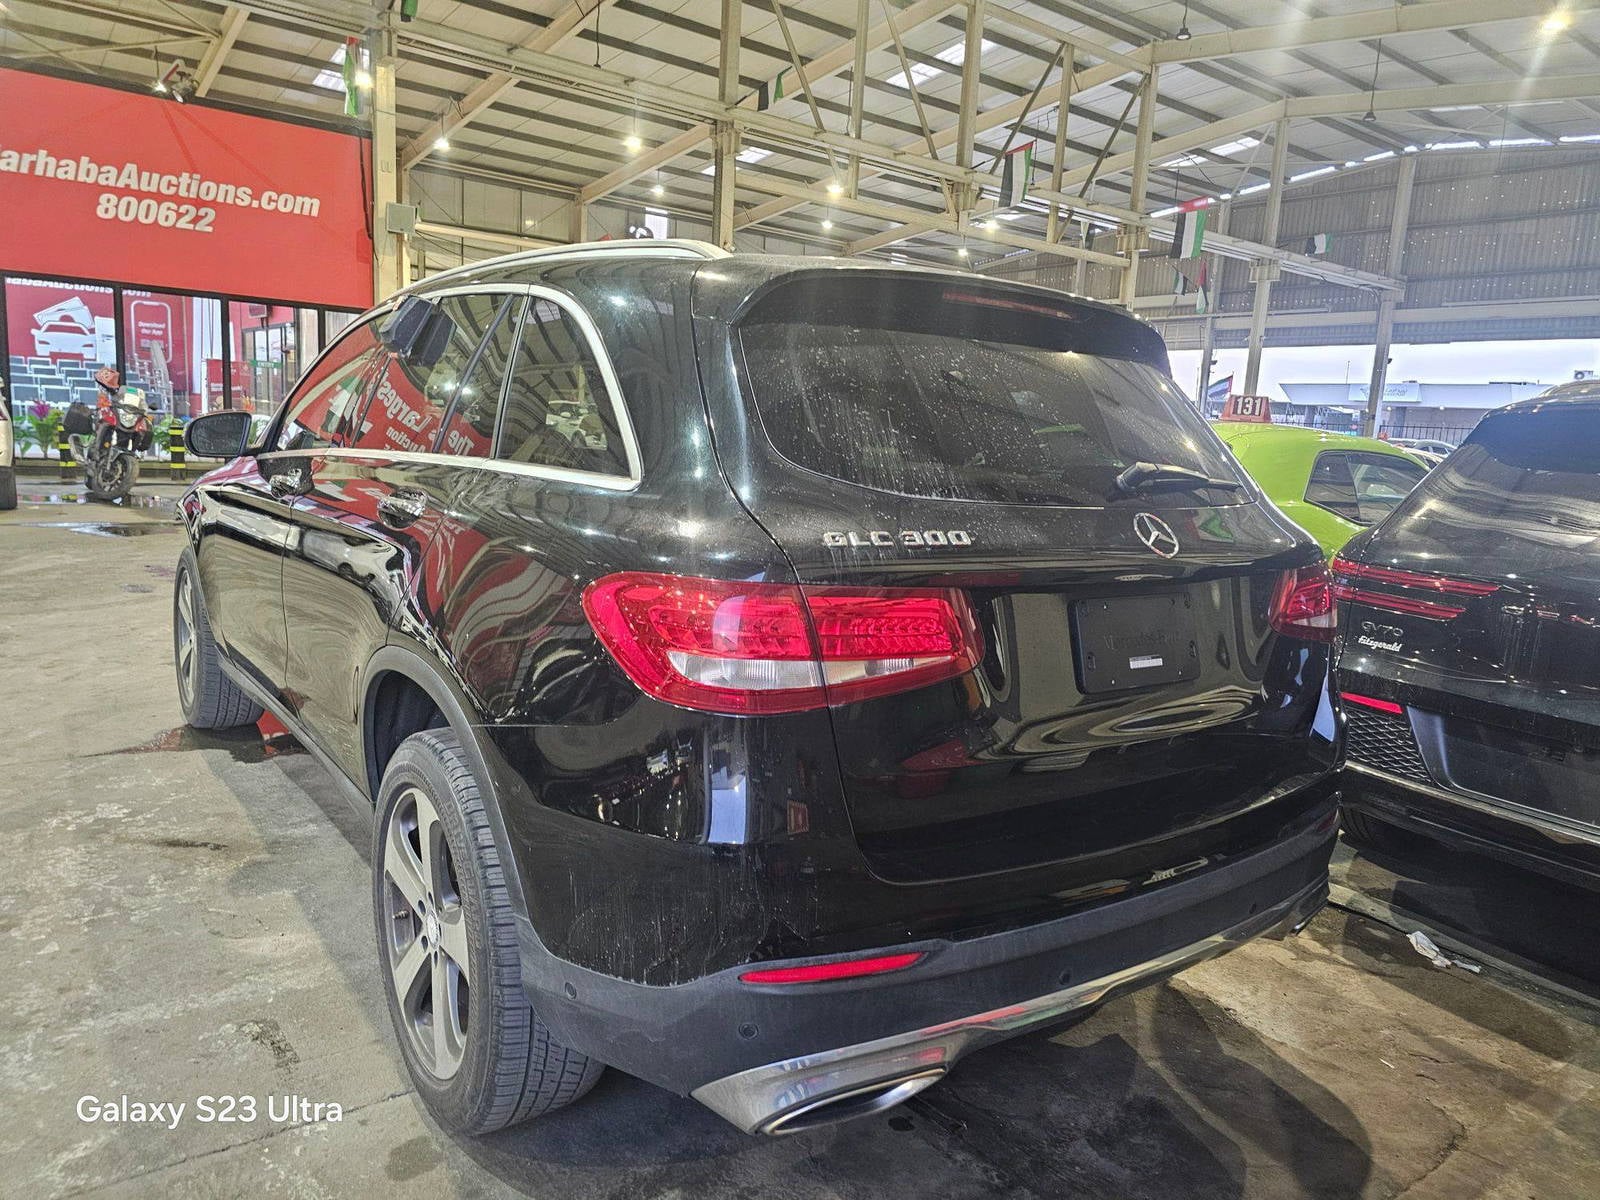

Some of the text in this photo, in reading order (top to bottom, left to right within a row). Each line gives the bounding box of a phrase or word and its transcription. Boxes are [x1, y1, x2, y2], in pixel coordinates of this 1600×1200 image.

[0, 144, 320, 217] arhabaAuctions.com
[96, 193, 216, 232] 800622
[1236, 396, 1262, 416] 131
[823, 531, 972, 547] GLC 300
[1361, 621, 1404, 637] GV70
